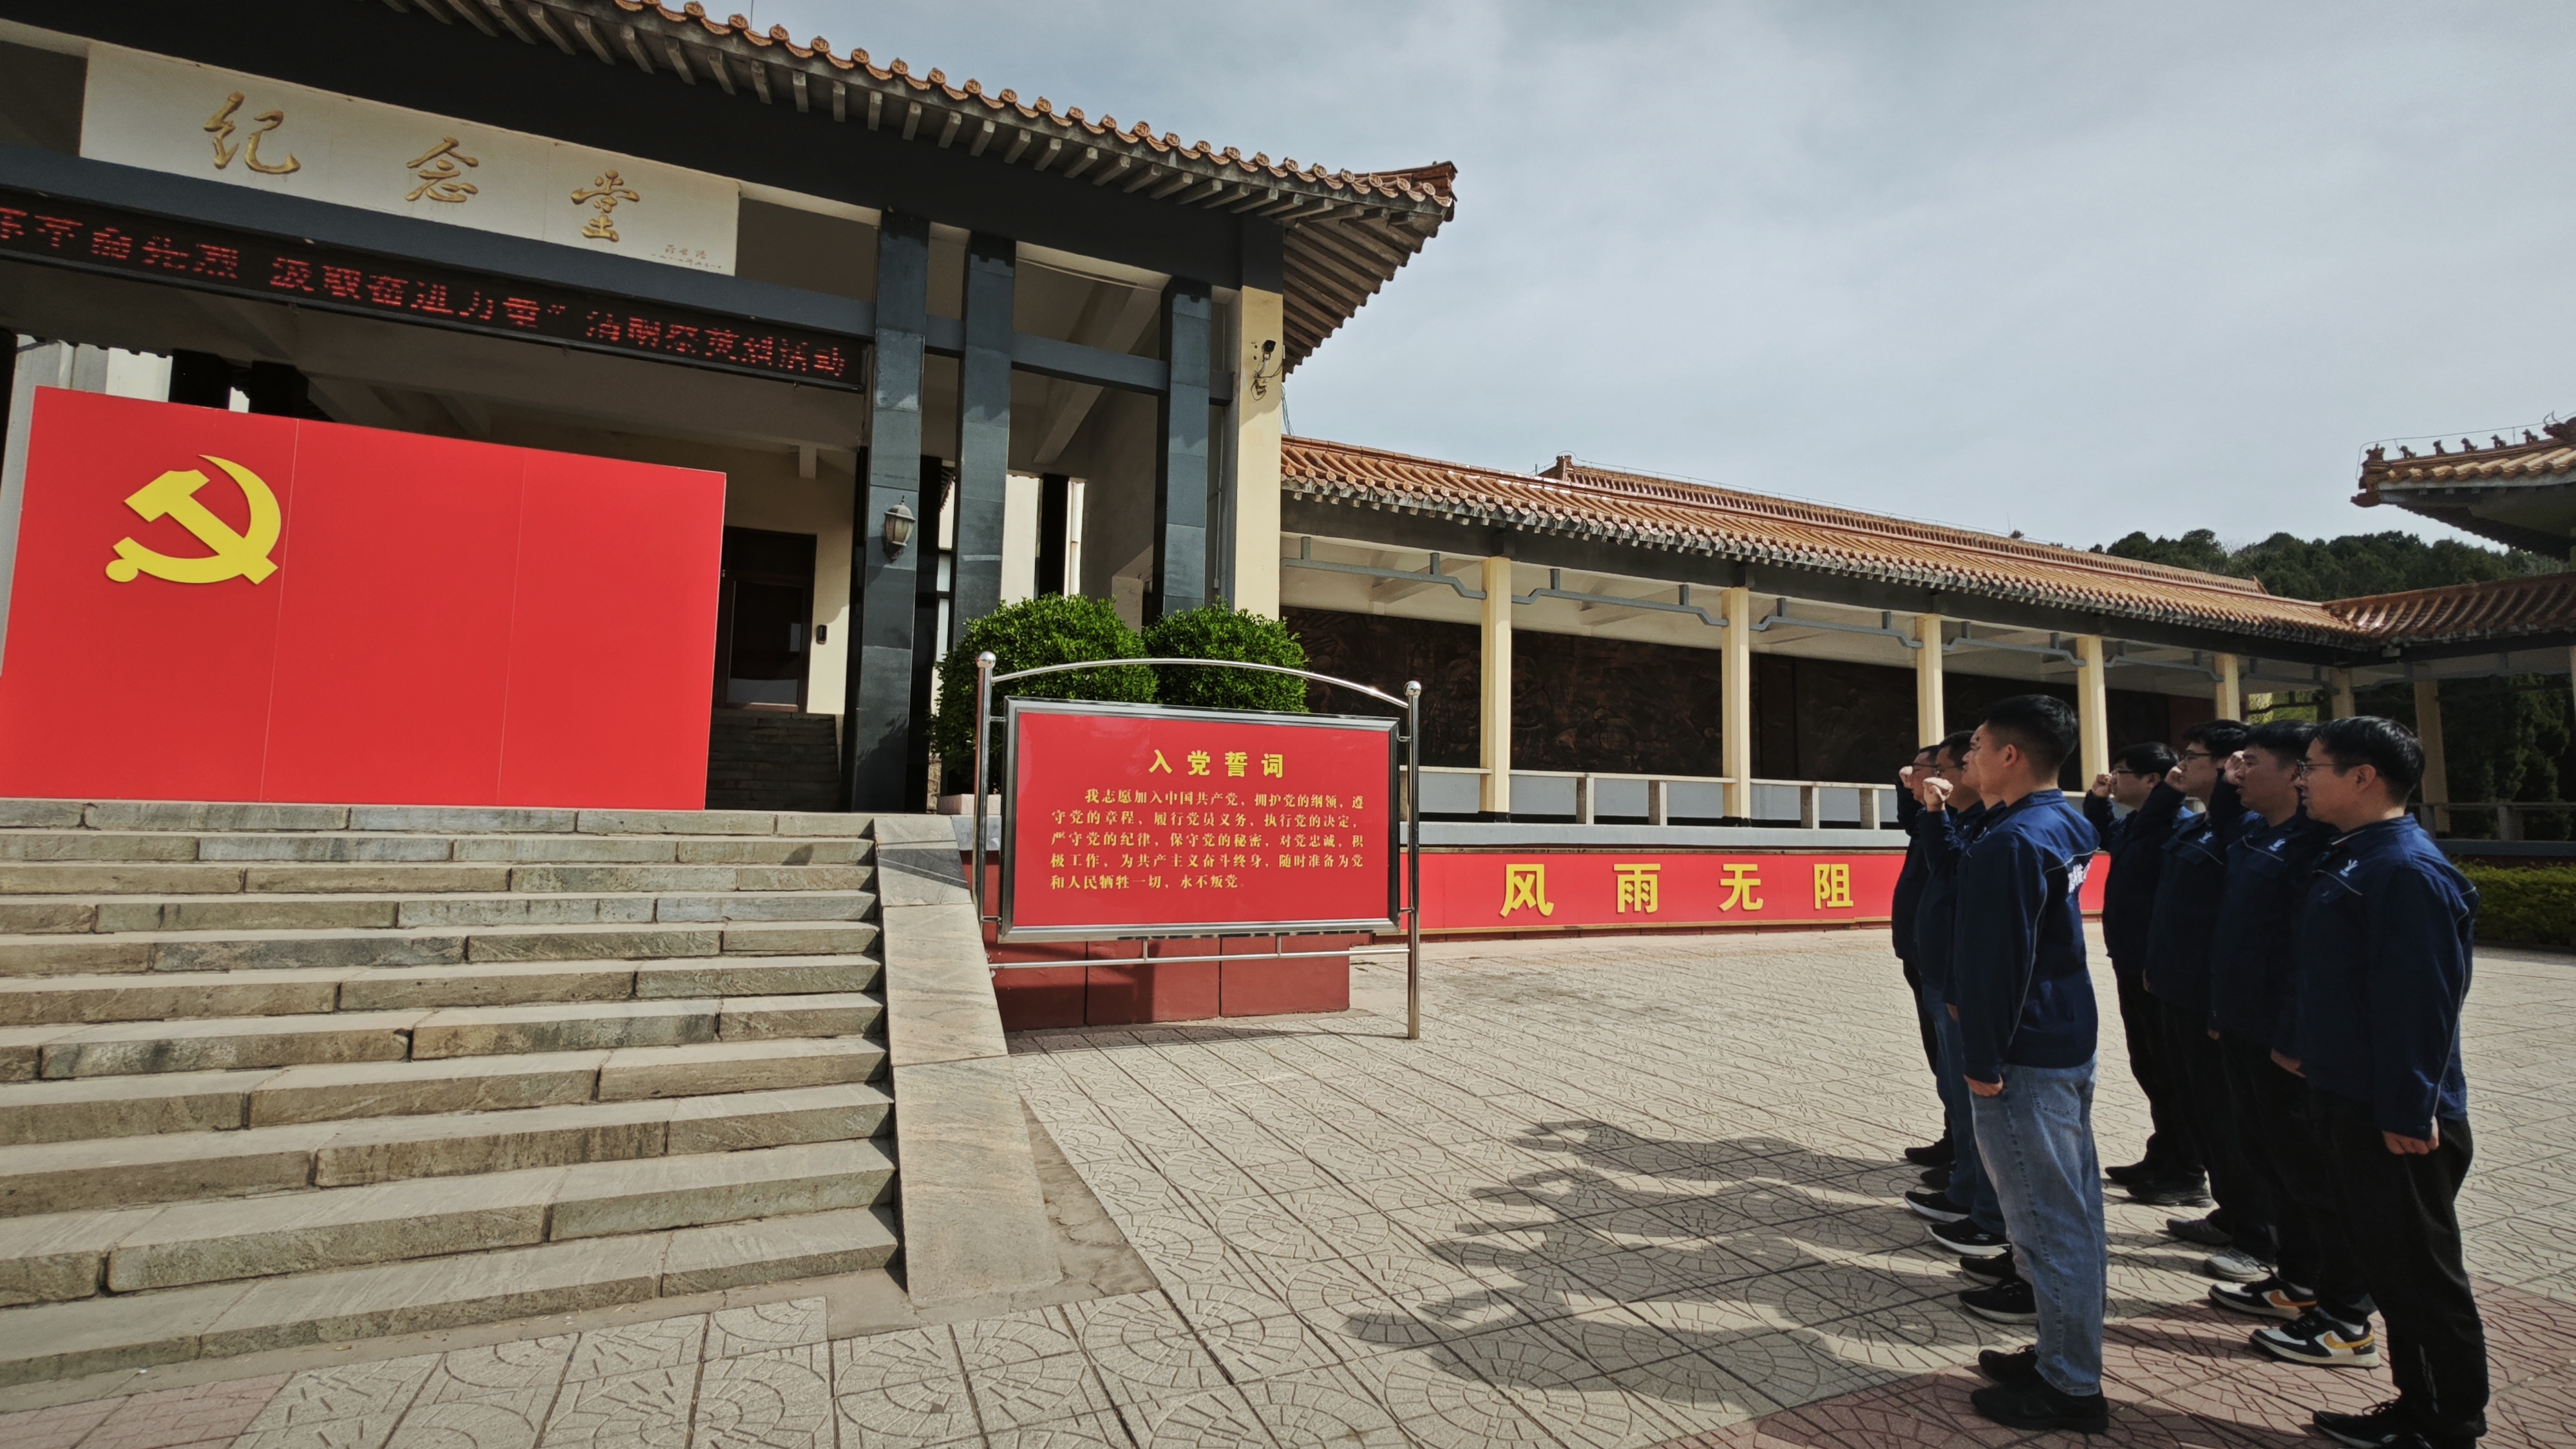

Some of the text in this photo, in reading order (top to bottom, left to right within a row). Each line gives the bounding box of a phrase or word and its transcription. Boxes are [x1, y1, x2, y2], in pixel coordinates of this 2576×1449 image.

[202, 91, 640, 243] 纪念堂
[1148, 749, 1283, 778] 入党誓词
[1050, 874, 1245, 890] 和人民牺牲一切，永不叛党。
[1500, 864, 1855, 917] 风雨无阻
